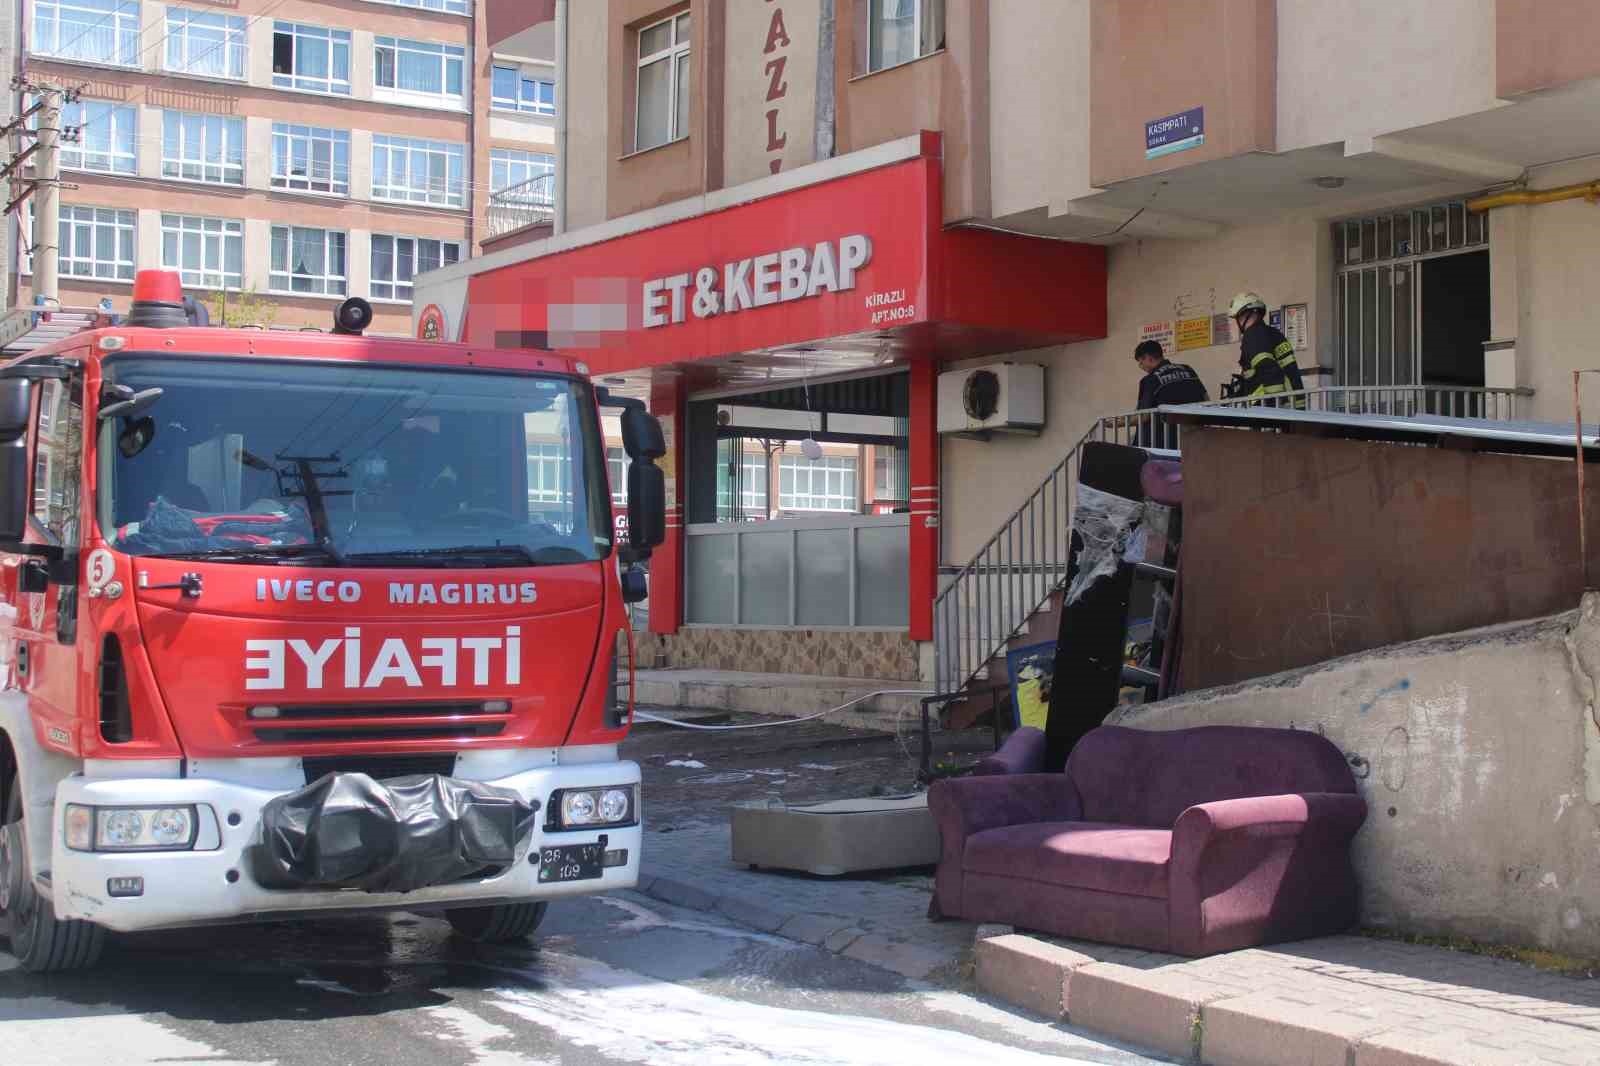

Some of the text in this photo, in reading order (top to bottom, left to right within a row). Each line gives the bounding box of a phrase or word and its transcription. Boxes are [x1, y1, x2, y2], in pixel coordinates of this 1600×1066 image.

[94, 554, 104, 581] 5
[256, 578, 537, 604] IVECO MAGIRUS
